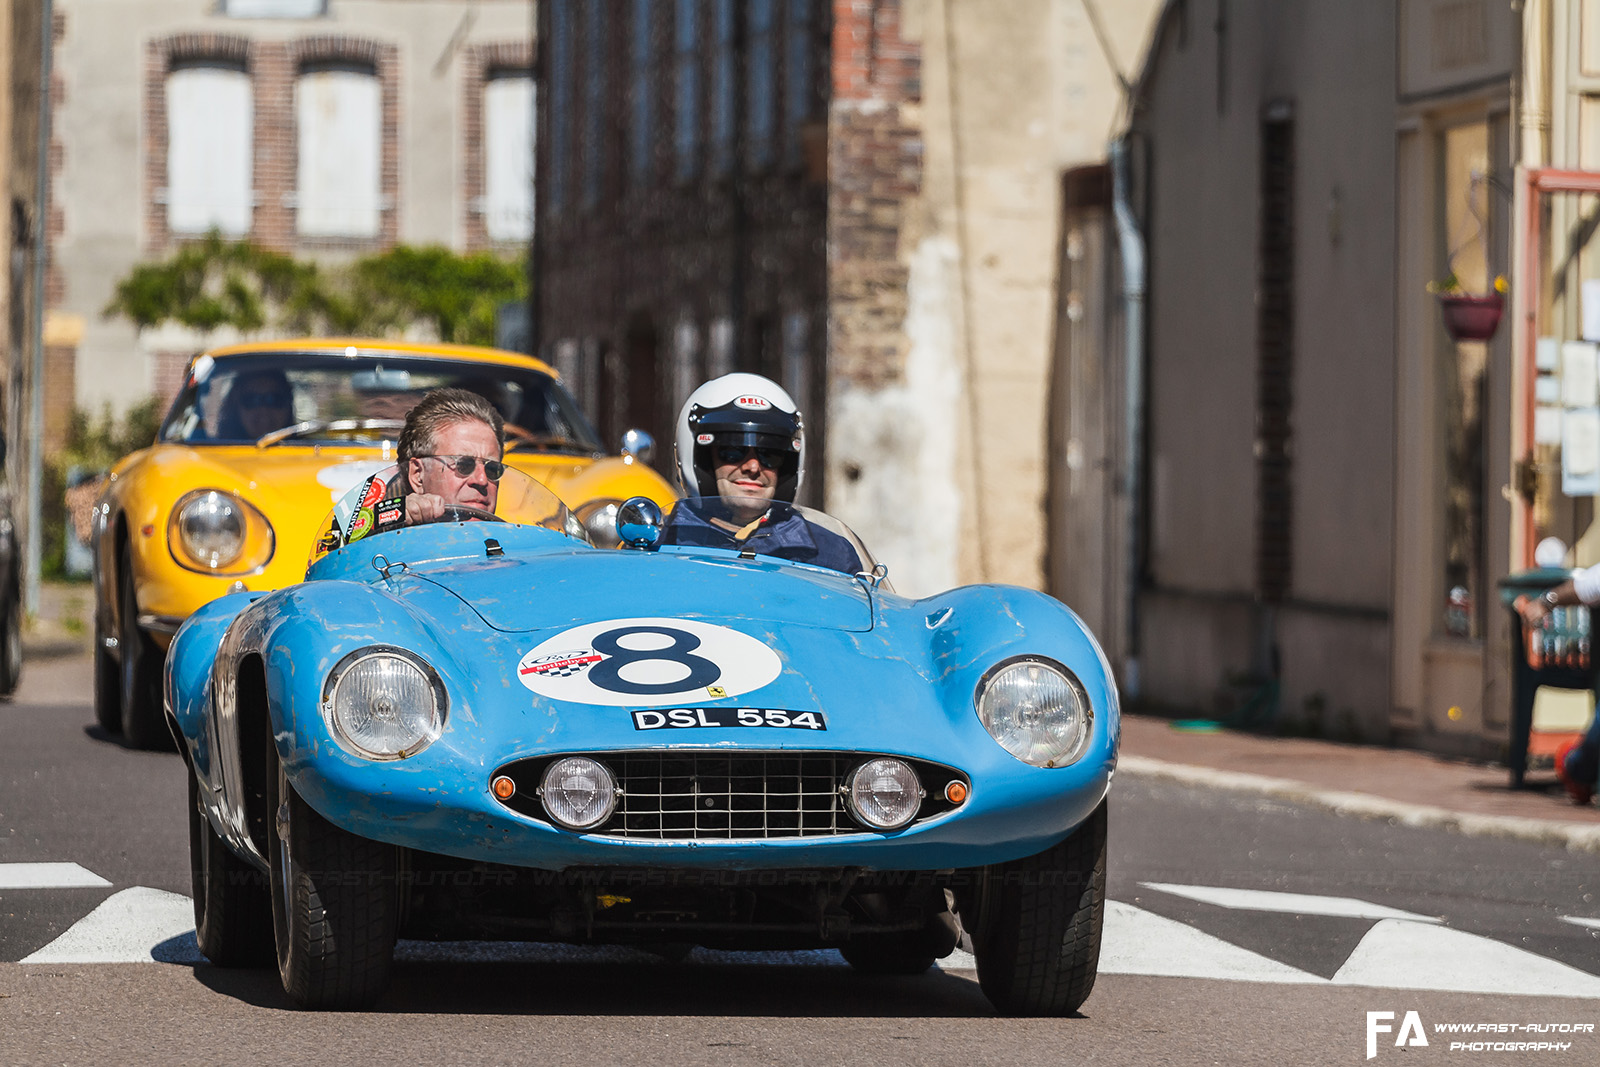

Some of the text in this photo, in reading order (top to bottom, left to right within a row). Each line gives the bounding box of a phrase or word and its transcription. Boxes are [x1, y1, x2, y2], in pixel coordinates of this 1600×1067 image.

[740, 398, 767, 406] BELL
[346, 511, 359, 536] ALAIN
[536, 657, 589, 672] Sotheby's
[588, 626, 721, 695] 8
[634, 708, 822, 730] DSL 554
